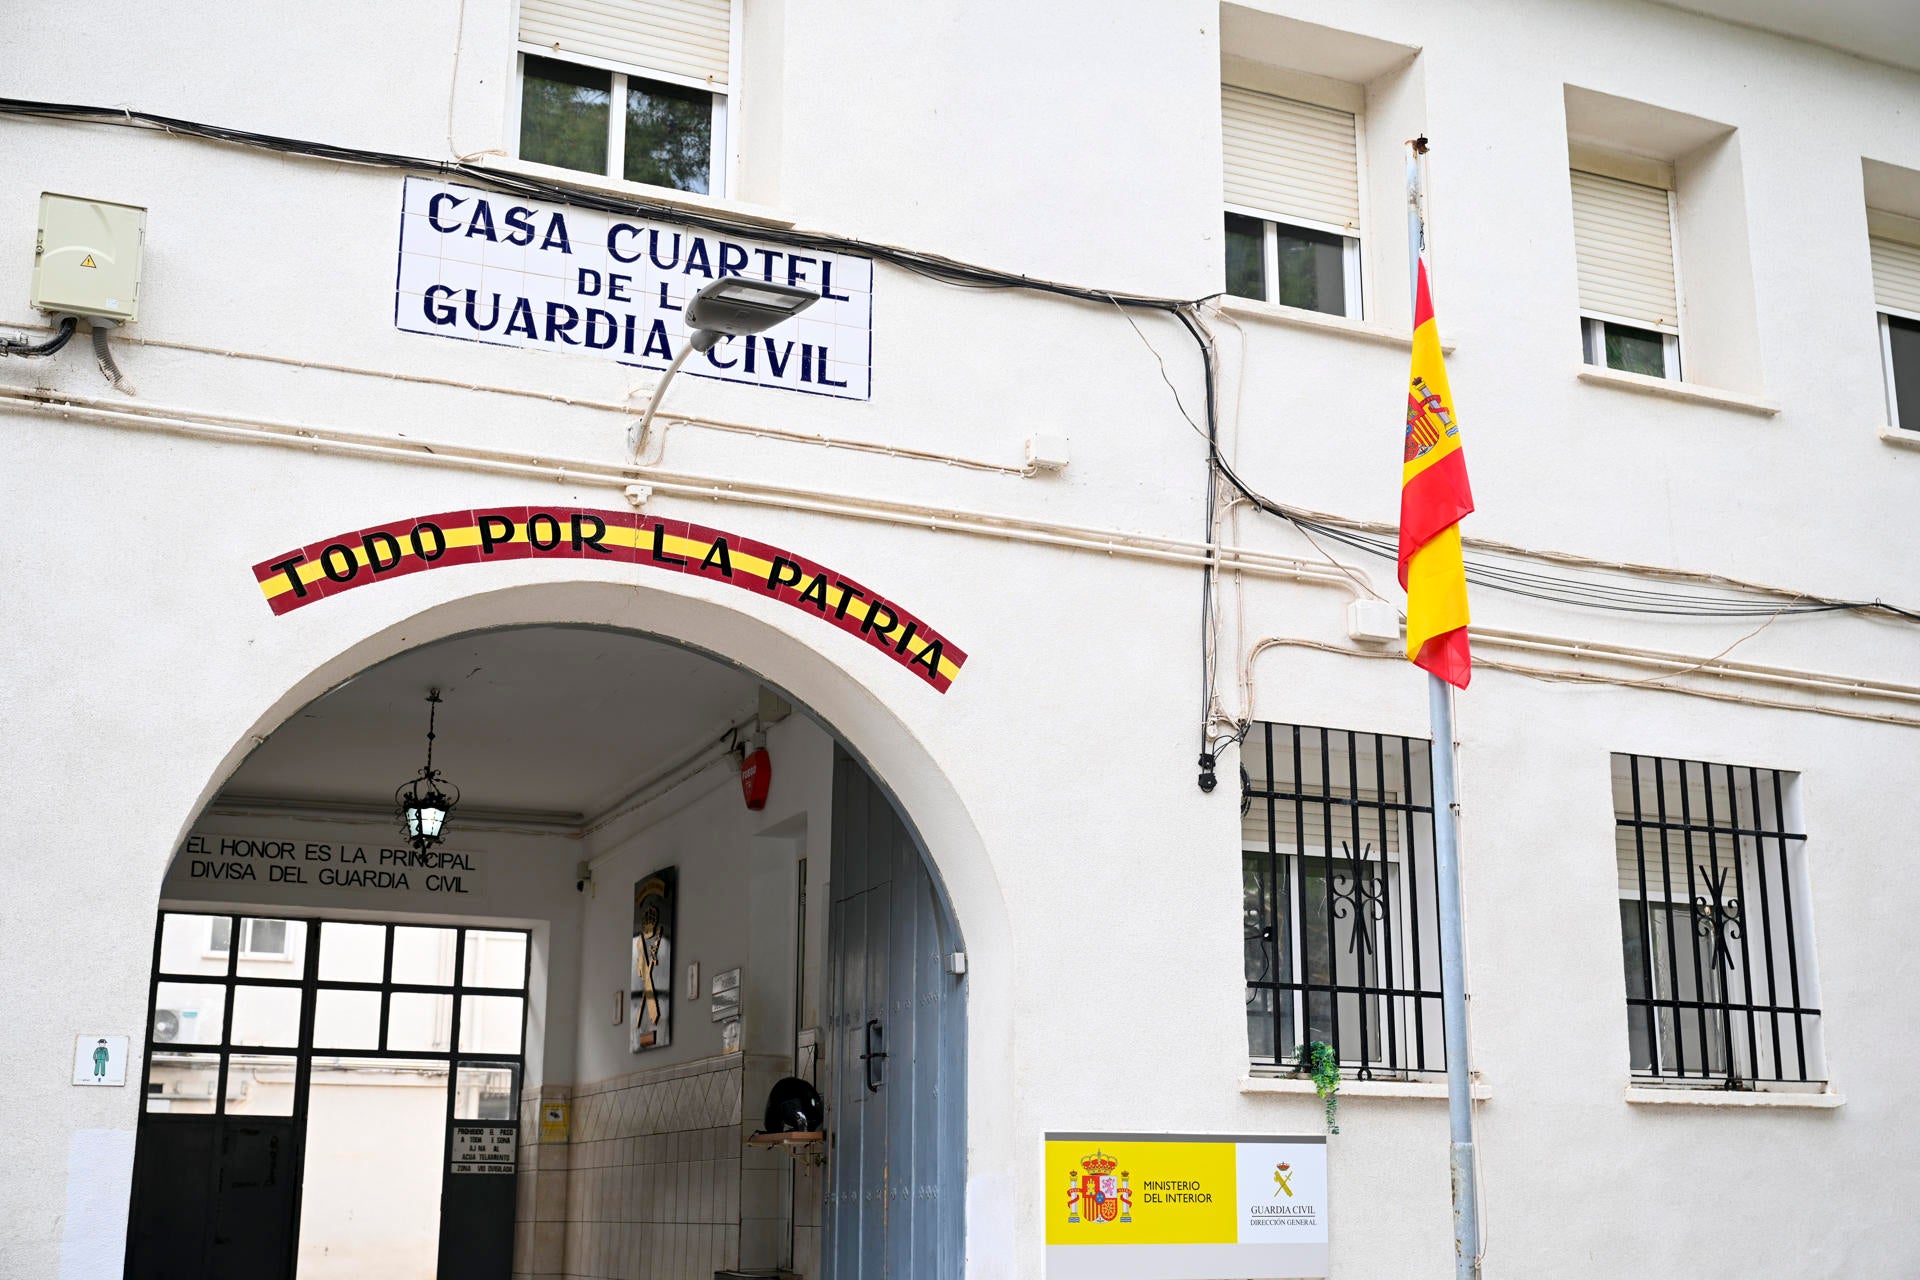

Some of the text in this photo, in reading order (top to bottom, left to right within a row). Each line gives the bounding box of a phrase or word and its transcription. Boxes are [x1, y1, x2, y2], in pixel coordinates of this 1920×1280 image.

[428, 192, 572, 255] CASA
[577, 267, 632, 303] DE
[423, 284, 849, 388] GUARDIA CIVIL
[270, 513, 945, 680] TODO POR LA PATRIA
[186, 836, 476, 871] EL HONOR ES LA PRINCIPAL
[191, 860, 469, 893] DIVISA DEL GUARDIA CIVIL
[1143, 1180, 1200, 1191] MINISTERIO
[1143, 1193, 1213, 1203] DEL INTERIOR
[1250, 1205, 1316, 1215] GUARDIA CIVIL
[1250, 1218, 1286, 1226] DIRECCIÓN
